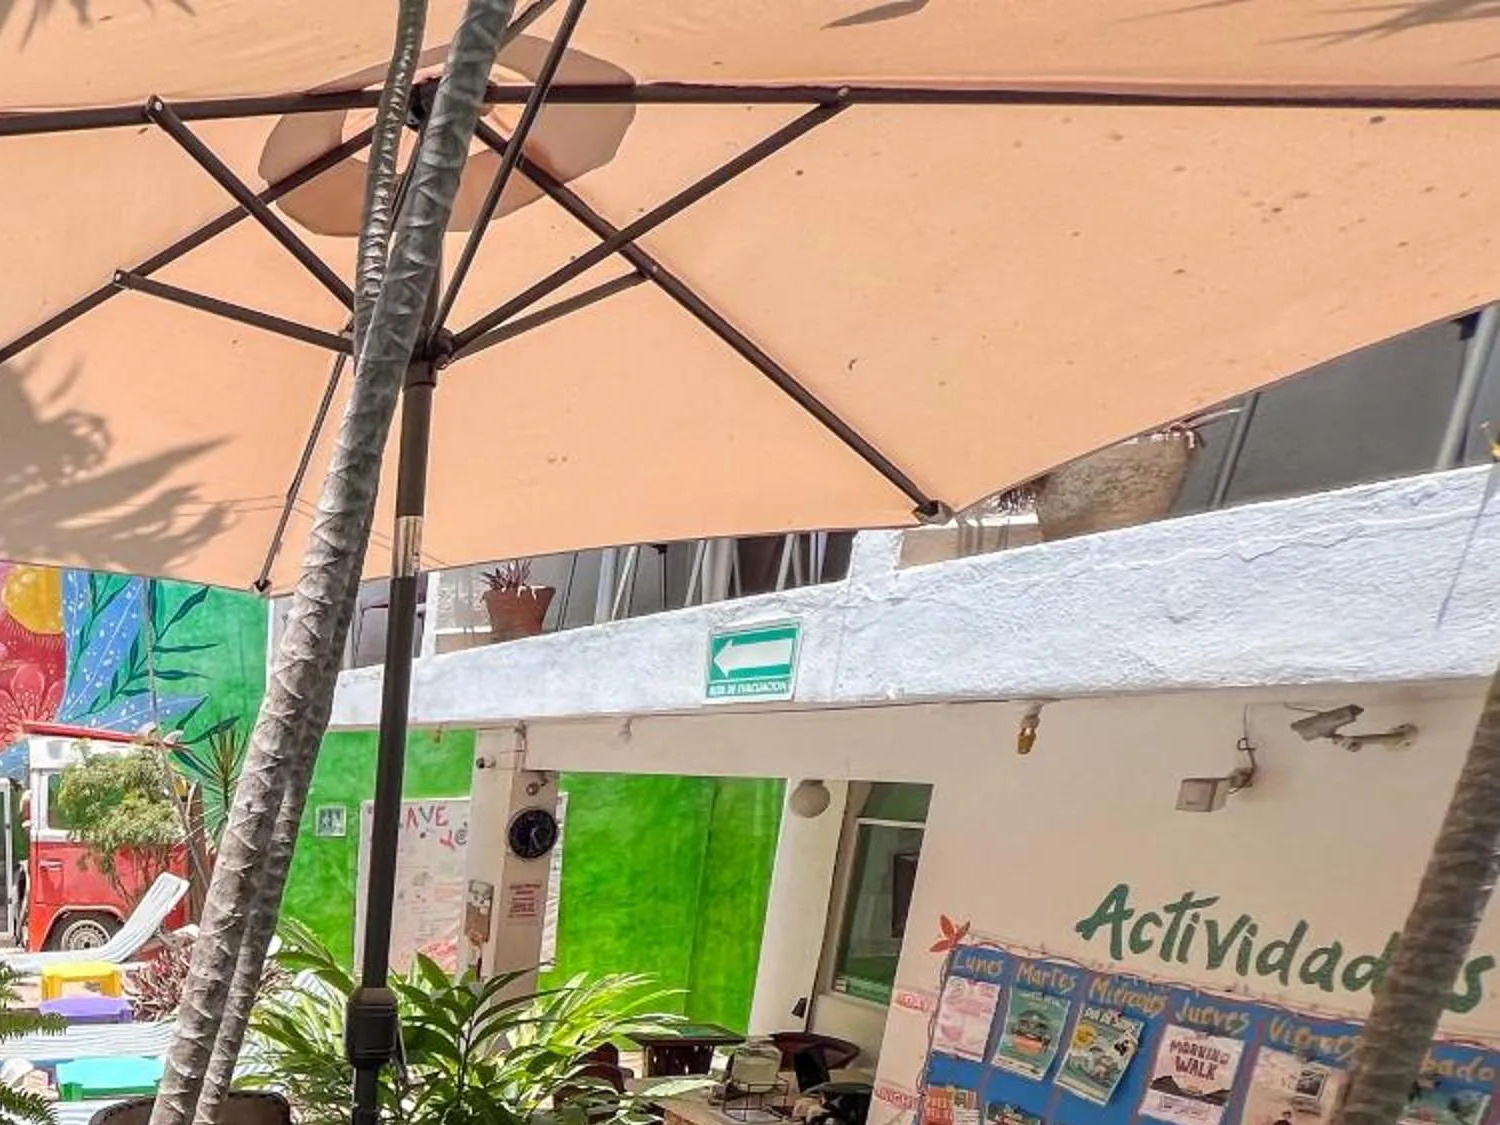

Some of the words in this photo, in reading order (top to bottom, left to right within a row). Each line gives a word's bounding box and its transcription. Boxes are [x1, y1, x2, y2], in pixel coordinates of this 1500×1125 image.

[1074, 883, 1496, 1013] Actividads
[953, 949, 1005, 975] Lunes
[1176, 997, 1251, 1036] Jueves
[1419, 1048, 1496, 1082] bado
[1169, 1038, 1231, 1066] MORNING
[1174, 1055, 1219, 1081] WALK
